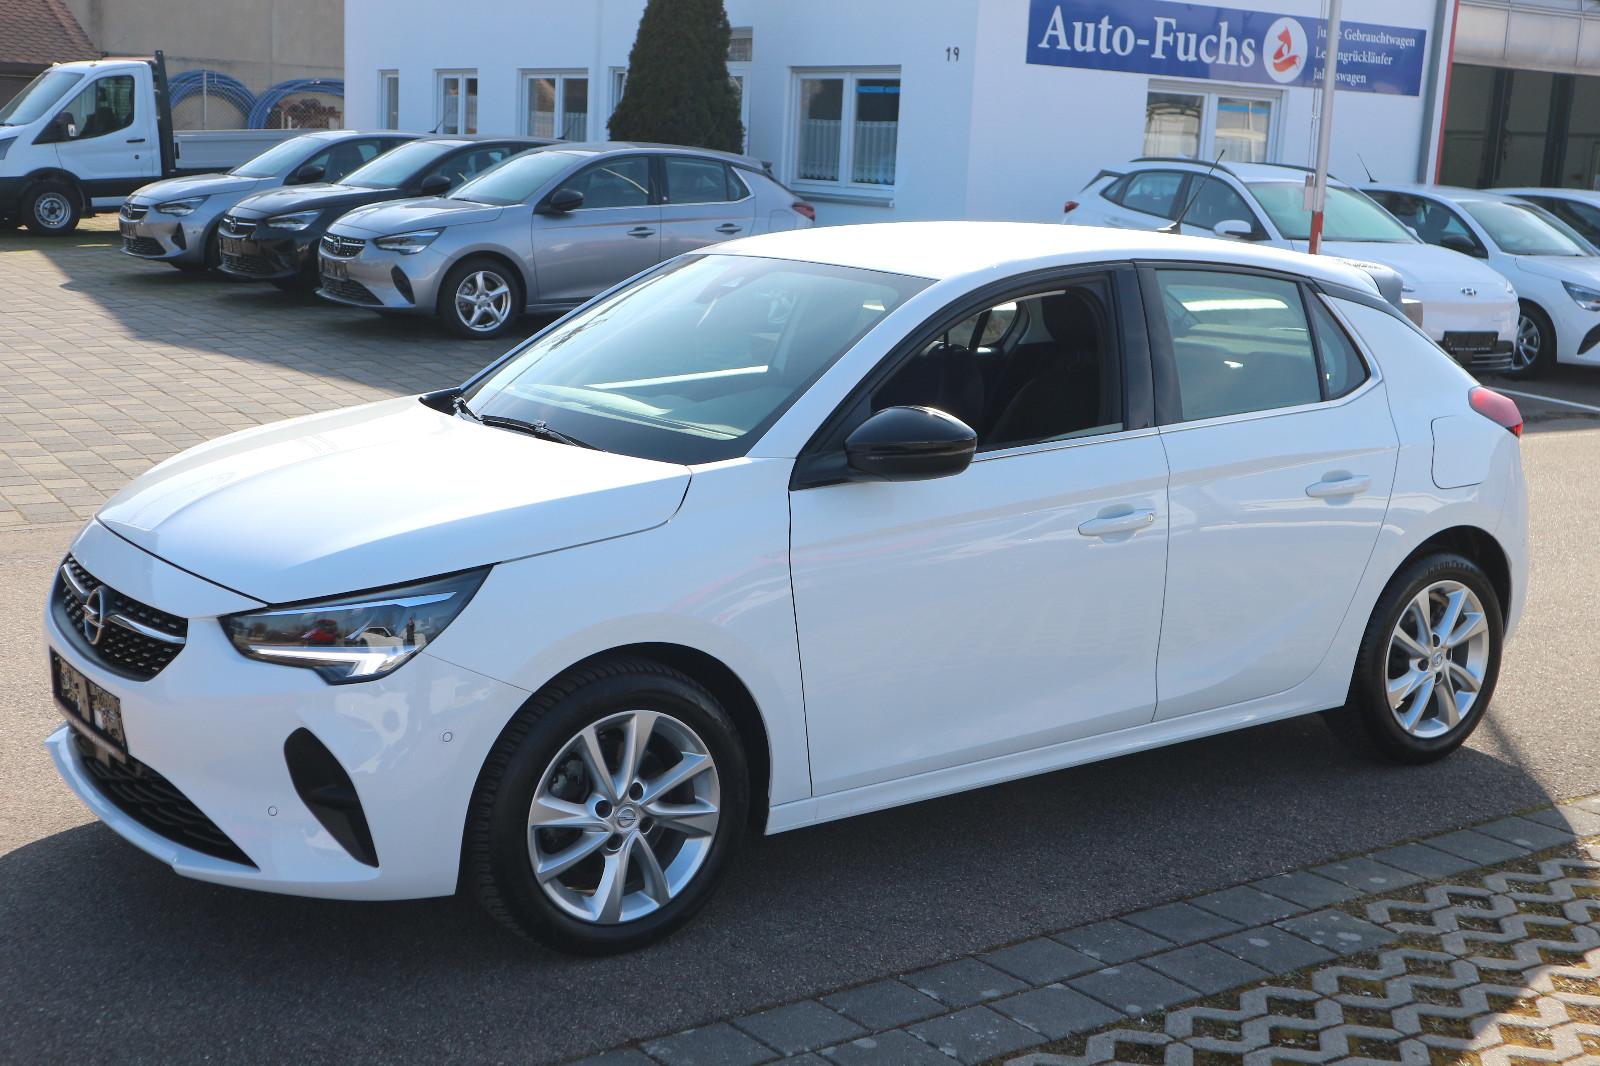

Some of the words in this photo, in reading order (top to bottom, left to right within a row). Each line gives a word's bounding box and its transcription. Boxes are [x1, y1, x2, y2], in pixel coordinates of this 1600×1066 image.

[1038, 5, 1255, 67] Auto-Fuchs
[1317, 25, 1342, 39] Jue
[1344, 28, 1416, 49] Gebrauchtwagen
[945, 46, 960, 61] 19
[1315, 46, 1393, 65] Lengrückläufer
